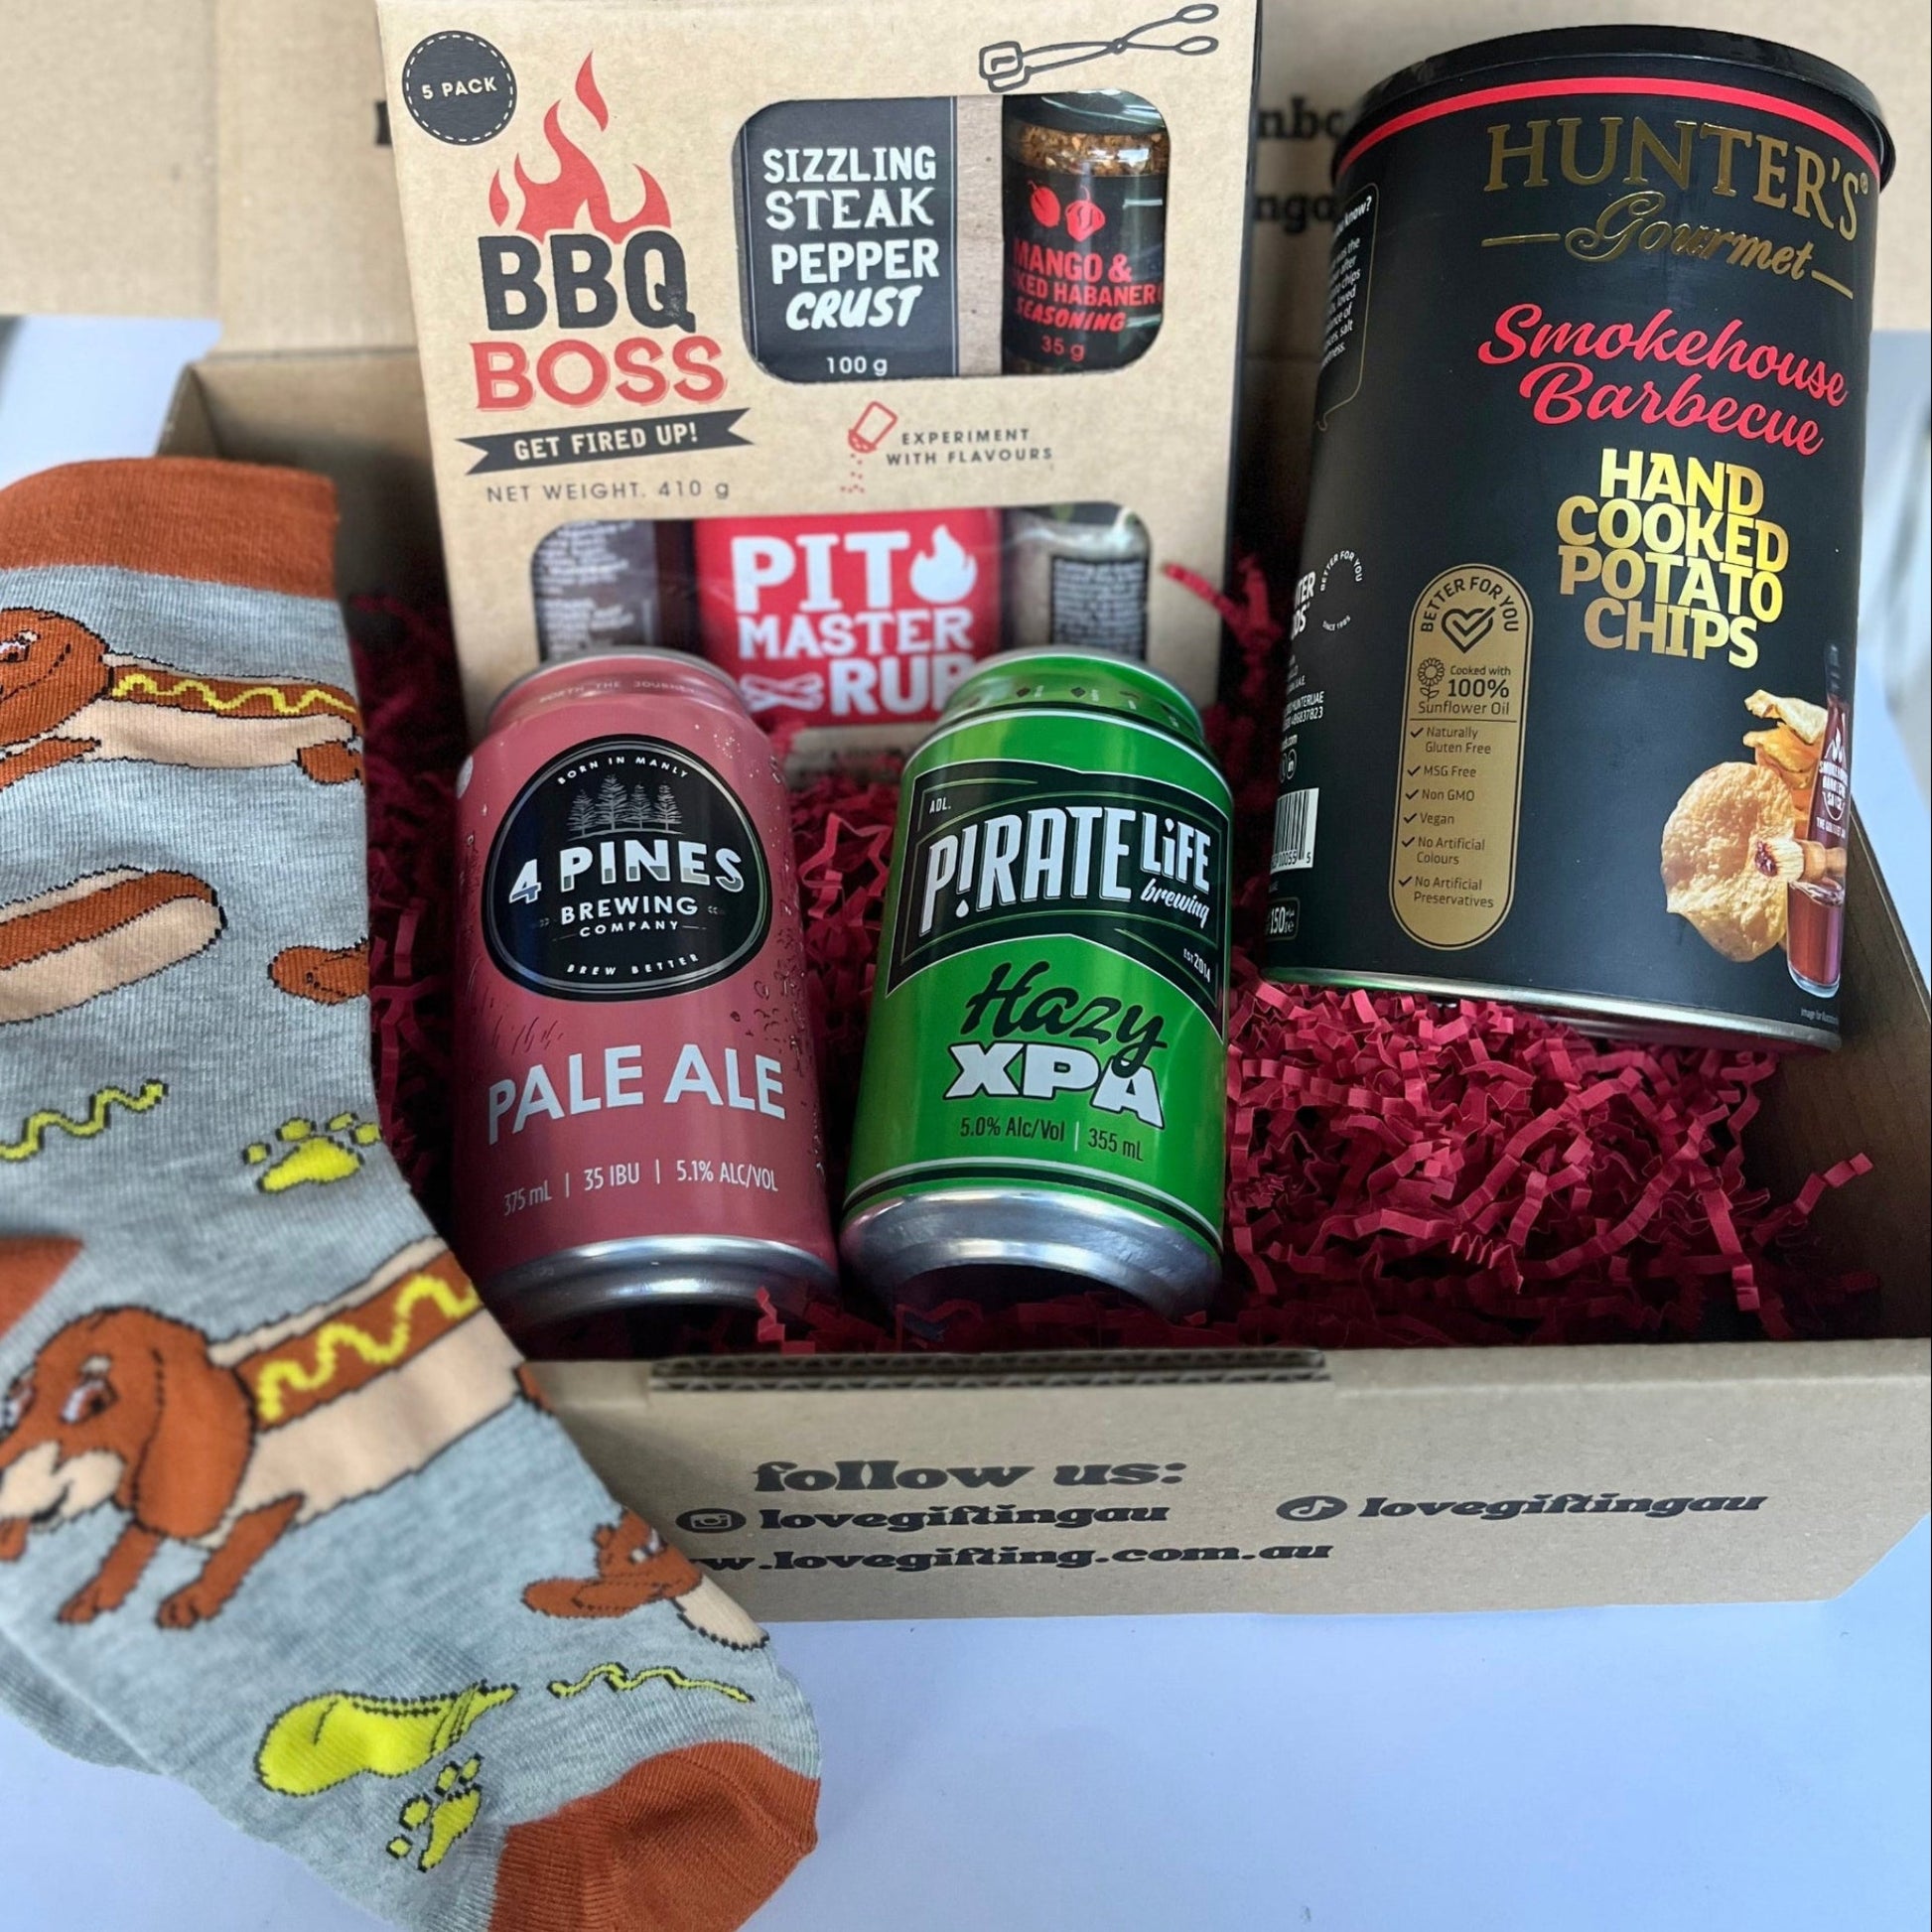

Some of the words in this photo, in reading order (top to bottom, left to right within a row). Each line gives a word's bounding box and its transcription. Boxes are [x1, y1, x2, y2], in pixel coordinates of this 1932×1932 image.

[422, 84, 433, 99] 5
[442, 76, 498, 97] PACK
[762, 146, 936, 184] SIZZLING
[764, 187, 935, 231] STEAK
[1565, 190, 1812, 280] Gourmet
[770, 238, 940, 284] PEPPER
[1014, 238, 1103, 283] MANGO
[1108, 253, 1132, 283] &
[478, 230, 696, 334] BBQ
[785, 285, 923, 331] CRUST
[1016, 297, 1127, 333] SEASONING
[1041, 336, 1065, 355] 35
[1070, 344, 1085, 362] g
[1478, 303, 1849, 407] Smokehouse
[470, 336, 728, 411] BOSS
[826, 356, 868, 374] 100
[873, 358, 889, 376] g
[1519, 361, 1825, 457] Barbecue
[513, 438, 561, 461] GET
[571, 428, 646, 456] FIRED
[655, 422, 699, 445] UP!
[901, 428, 1031, 445] EXPERIMENT
[886, 452, 937, 466] WITH
[947, 448, 1053, 464] FLAVOURS
[486, 485, 530, 502] NET
[543, 483, 646, 500] WEIGHT.
[658, 480, 703, 497] 410
[715, 482, 731, 500] g
[1598, 448, 1765, 518] HAND
[1556, 496, 1789, 574] COOKED
[730, 530, 910, 614] PIT
[1353, 558, 1363, 583] YOU
[1560, 545, 1784, 623] POTATO
[1421, 578, 1465, 632] BETTER
[1469, 576, 1503, 598] FOR
[1498, 596, 1519, 632] YOU
[738, 608, 973, 659] MASTER
[1584, 596, 1759, 669] CHIPS
[597, 680, 621, 690] THE
[1449, 665, 1486, 676] Cooked
[1488, 665, 1511, 677] with
[1447, 678, 1510, 700] 100%
[1417, 700, 1488, 715] Sunflower
[1490, 701, 1510, 716] Oil
[1425, 742, 1462, 755] Gluten
[1465, 742, 1491, 755] Free
[1426, 726, 1478, 741] Naturally
[557, 760, 599, 784] BORN
[609, 757, 624, 765] IN
[635, 757, 689, 778] MANLY
[1423, 765, 1449, 777] MSG
[1450, 765, 1476, 777] Free
[929, 797, 951, 813] ADL.
[1422, 789, 1445, 801] Non
[1447, 789, 1475, 802] GMO
[1420, 812, 1454, 826] Vegan
[1417, 852, 1459, 866] Colours
[1418, 837, 1434, 849] No
[1436, 837, 1485, 852] Artificial
[508, 858, 542, 904] 4
[559, 839, 745, 894] PINES
[1415, 876, 1430, 889] No
[1432, 876, 1483, 892] Artificial
[561, 896, 698, 925] BREWING
[1141, 878, 1210, 929] brewing
[1414, 891, 1494, 908] Preservatives
[579, 919, 679, 937] COMPANY
[567, 963, 617, 976] BREW
[631, 954, 699, 975] BETTER
[1194, 952, 1211, 983] 2014
[961, 960, 1167, 1078] Hazy
[487, 1044, 643, 1146] PALE
[662, 1042, 786, 1120] ALE
[943, 1041, 1166, 1130] XPA
[960, 1116, 1002, 1139] 5.0%
[1005, 1117, 1064, 1143] Alc/Vol
[1087, 1127, 1118, 1153] 355
[1122, 1136, 1144, 1163] mL
[584, 1167, 605, 1191] 35
[609, 1163, 640, 1187] IBU
[676, 1160, 714, 1182] 5.1%
[719, 1162, 779, 1191] ALC/VOL
[503, 1188, 526, 1216] 375
[529, 1179, 553, 1206] mL
[754, 1459, 1035, 1492] follow
[1052, 1461, 1189, 1487] us:
[759, 1502, 1171, 1532] lovegiftingau
[1357, 1492, 1769, 1521] lovegiftingau
[689, 1543, 1334, 1573] w.lovegifting.com.au
